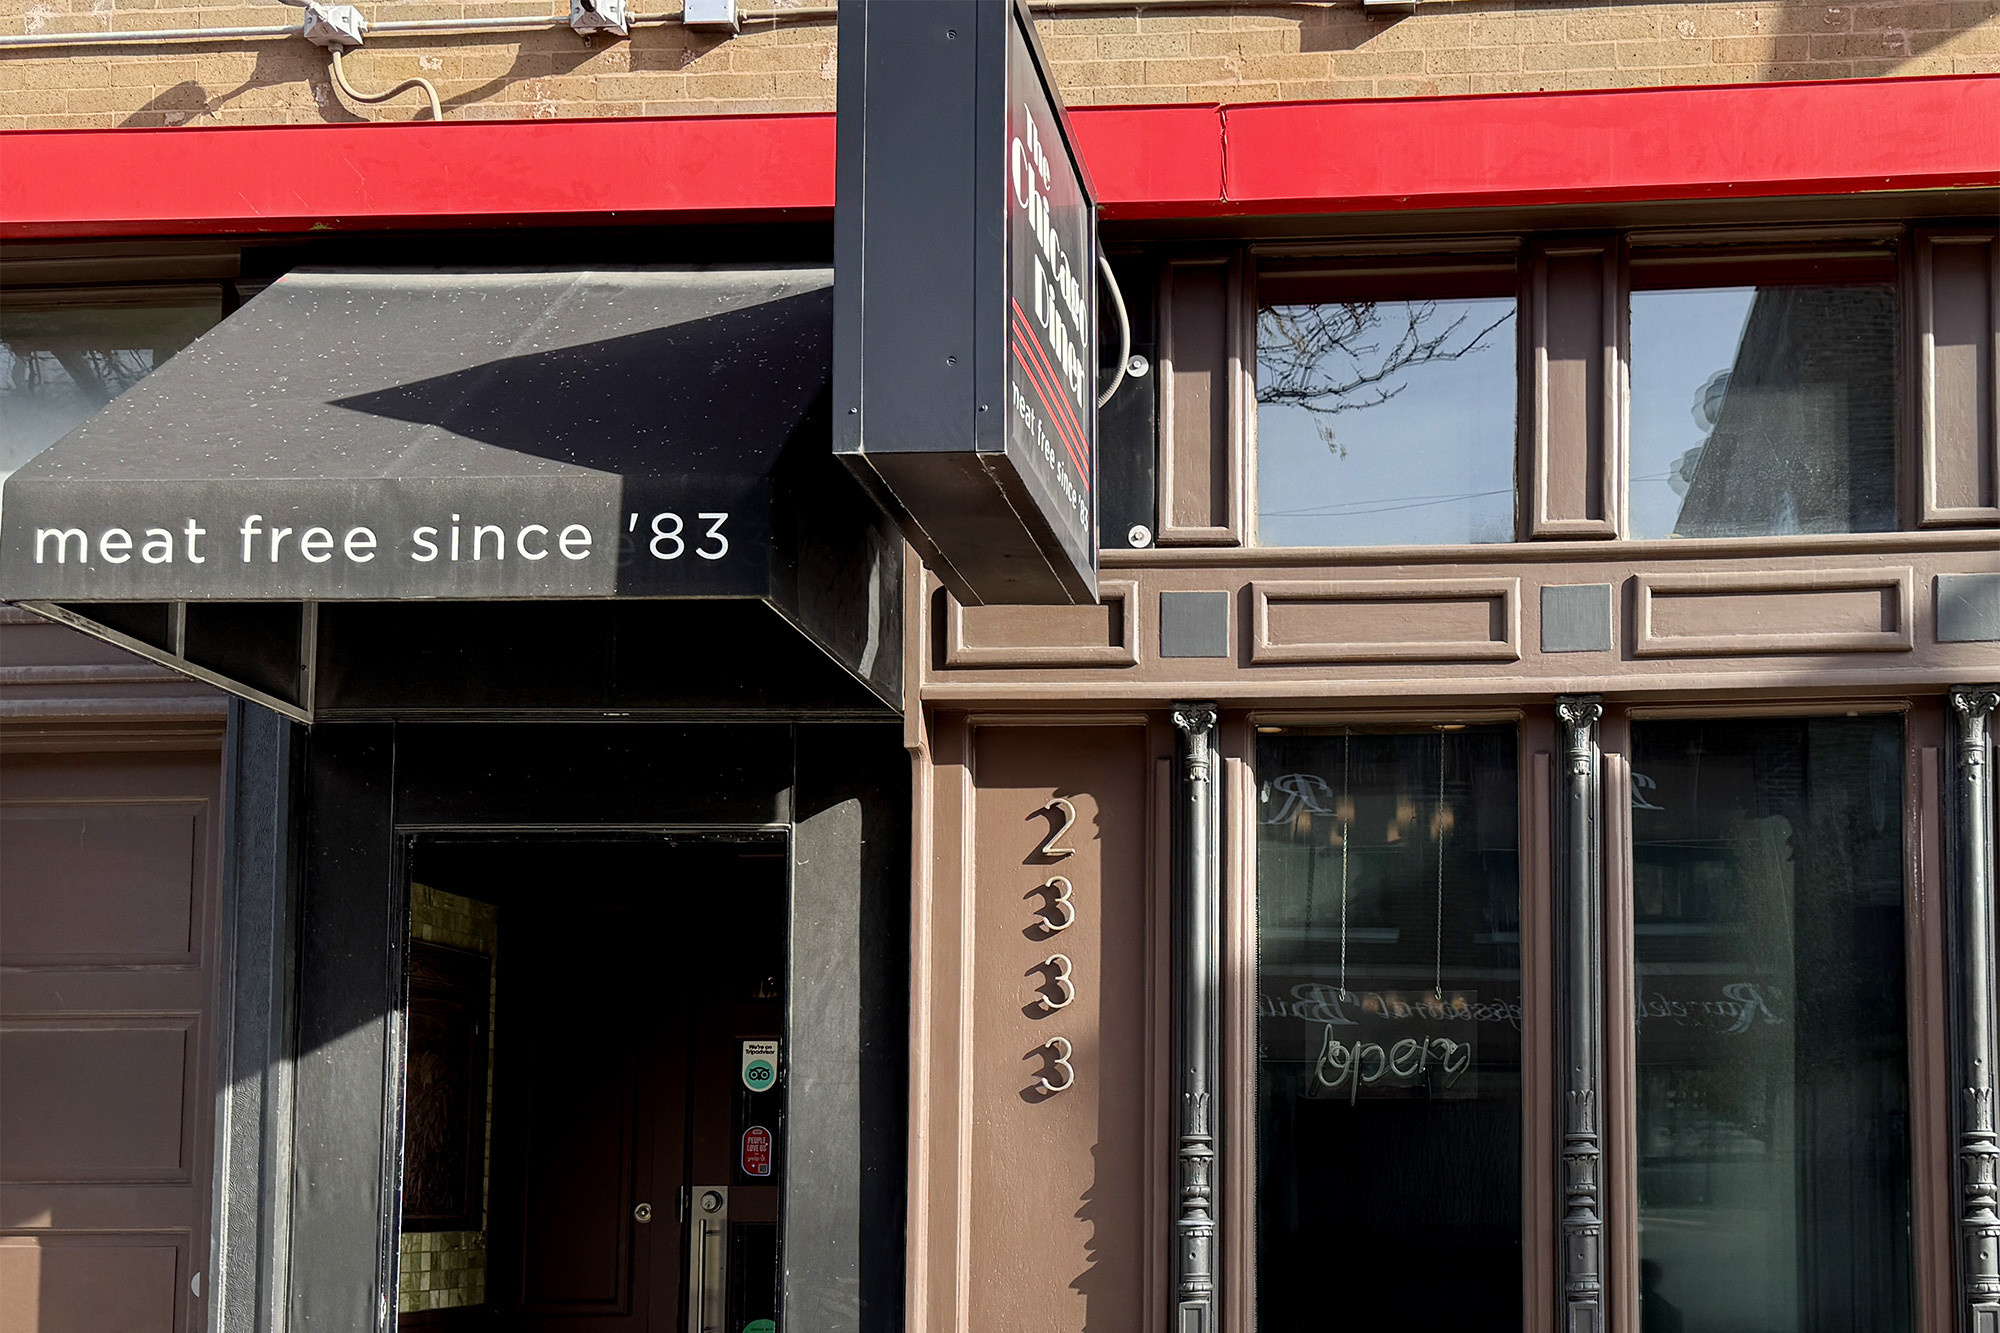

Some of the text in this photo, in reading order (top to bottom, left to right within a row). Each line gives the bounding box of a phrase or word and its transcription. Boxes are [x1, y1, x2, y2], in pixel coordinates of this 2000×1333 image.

[1023, 103, 1051, 191] The
[1011, 136, 1089, 348] Chicago
[1034, 253, 1085, 408] Diner
[1012, 380, 1089, 533] meat free since '83
[35, 512, 731, 565] meat free since '83
[1311, 1023, 1472, 1106] open
[747, 1136, 766, 1144] PEOPLE
[747, 1144, 759, 1152] LOVE
